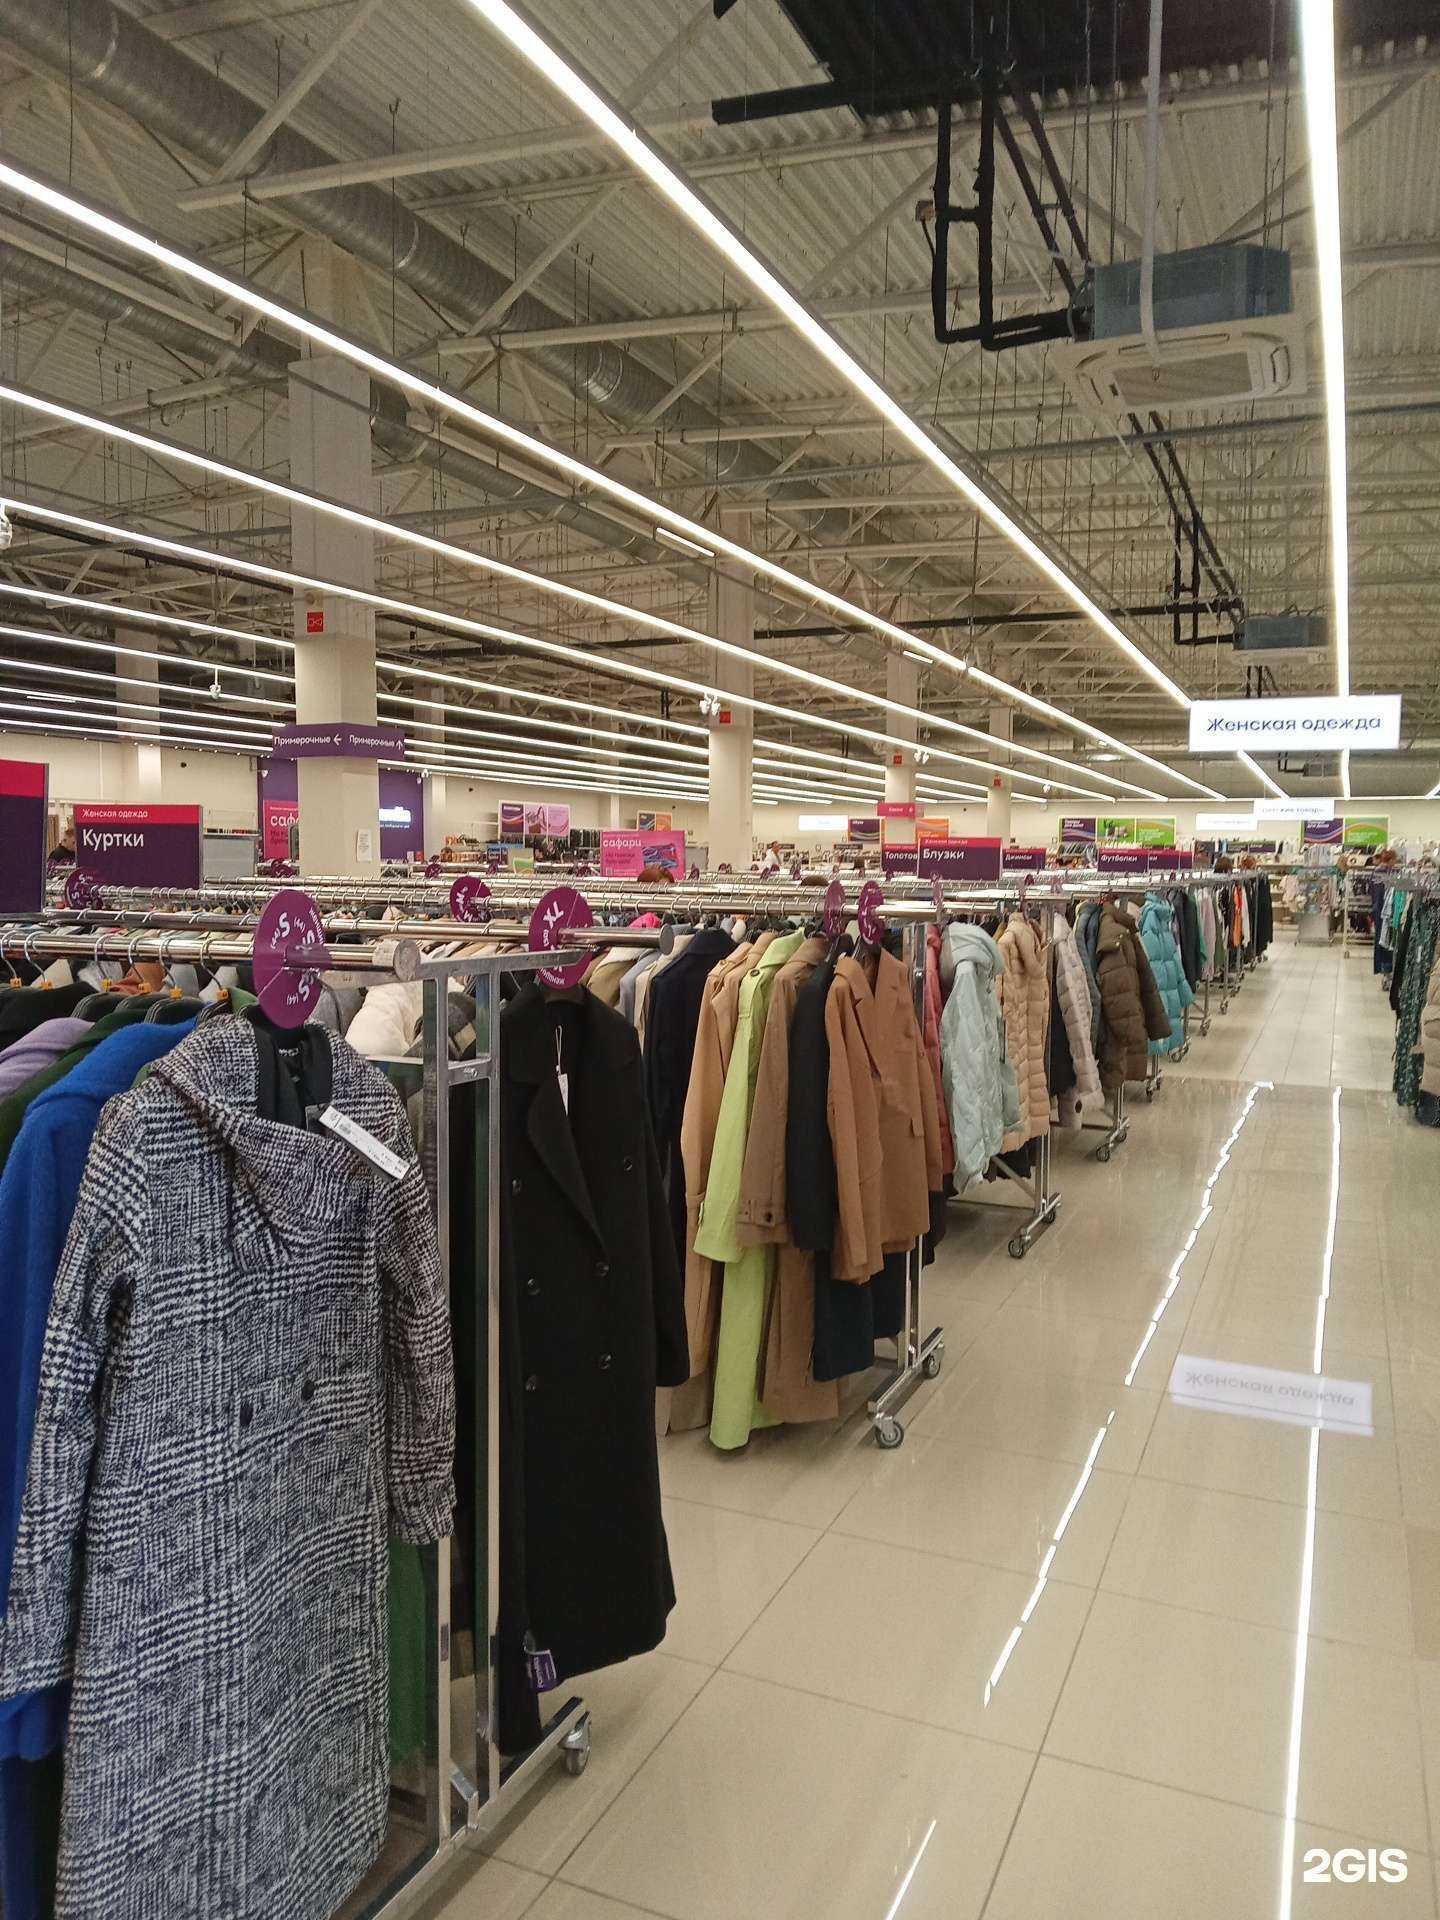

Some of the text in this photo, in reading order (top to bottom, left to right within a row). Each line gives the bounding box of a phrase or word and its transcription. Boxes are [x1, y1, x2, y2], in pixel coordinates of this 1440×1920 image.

[1207, 716, 1381, 732] Женская одежда
[274, 735, 331, 747] Примерочные
[349, 734, 396, 747] Примерочные
[82, 808, 149, 819] Женская одежда
[82, 828, 144, 852] Куртки
[602, 838, 642, 850] сафари
[923, 849, 965, 861] Блузки
[1100, 854, 1138, 863] Футболки
[543, 901, 565, 929] XL
[278, 912, 291, 938] S
